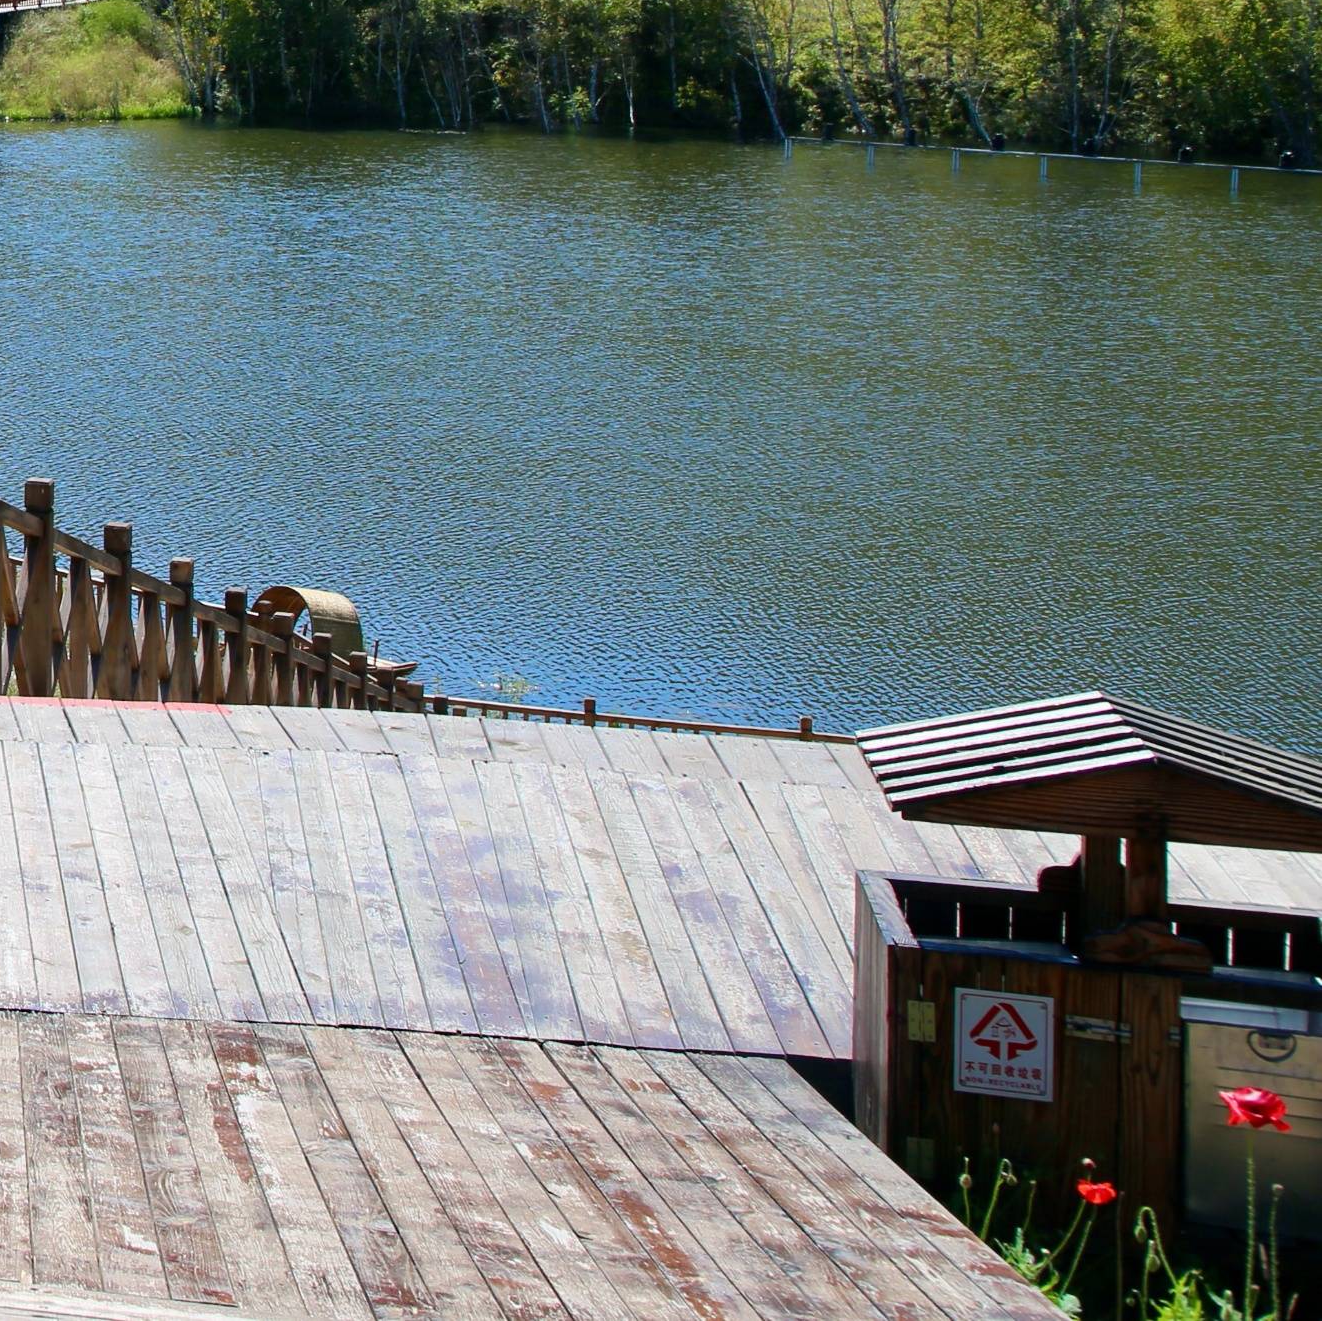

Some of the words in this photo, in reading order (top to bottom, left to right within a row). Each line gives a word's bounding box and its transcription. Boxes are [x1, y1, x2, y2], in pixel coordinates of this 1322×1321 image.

[965, 1061, 1042, 1080] 不可回收垃圾
